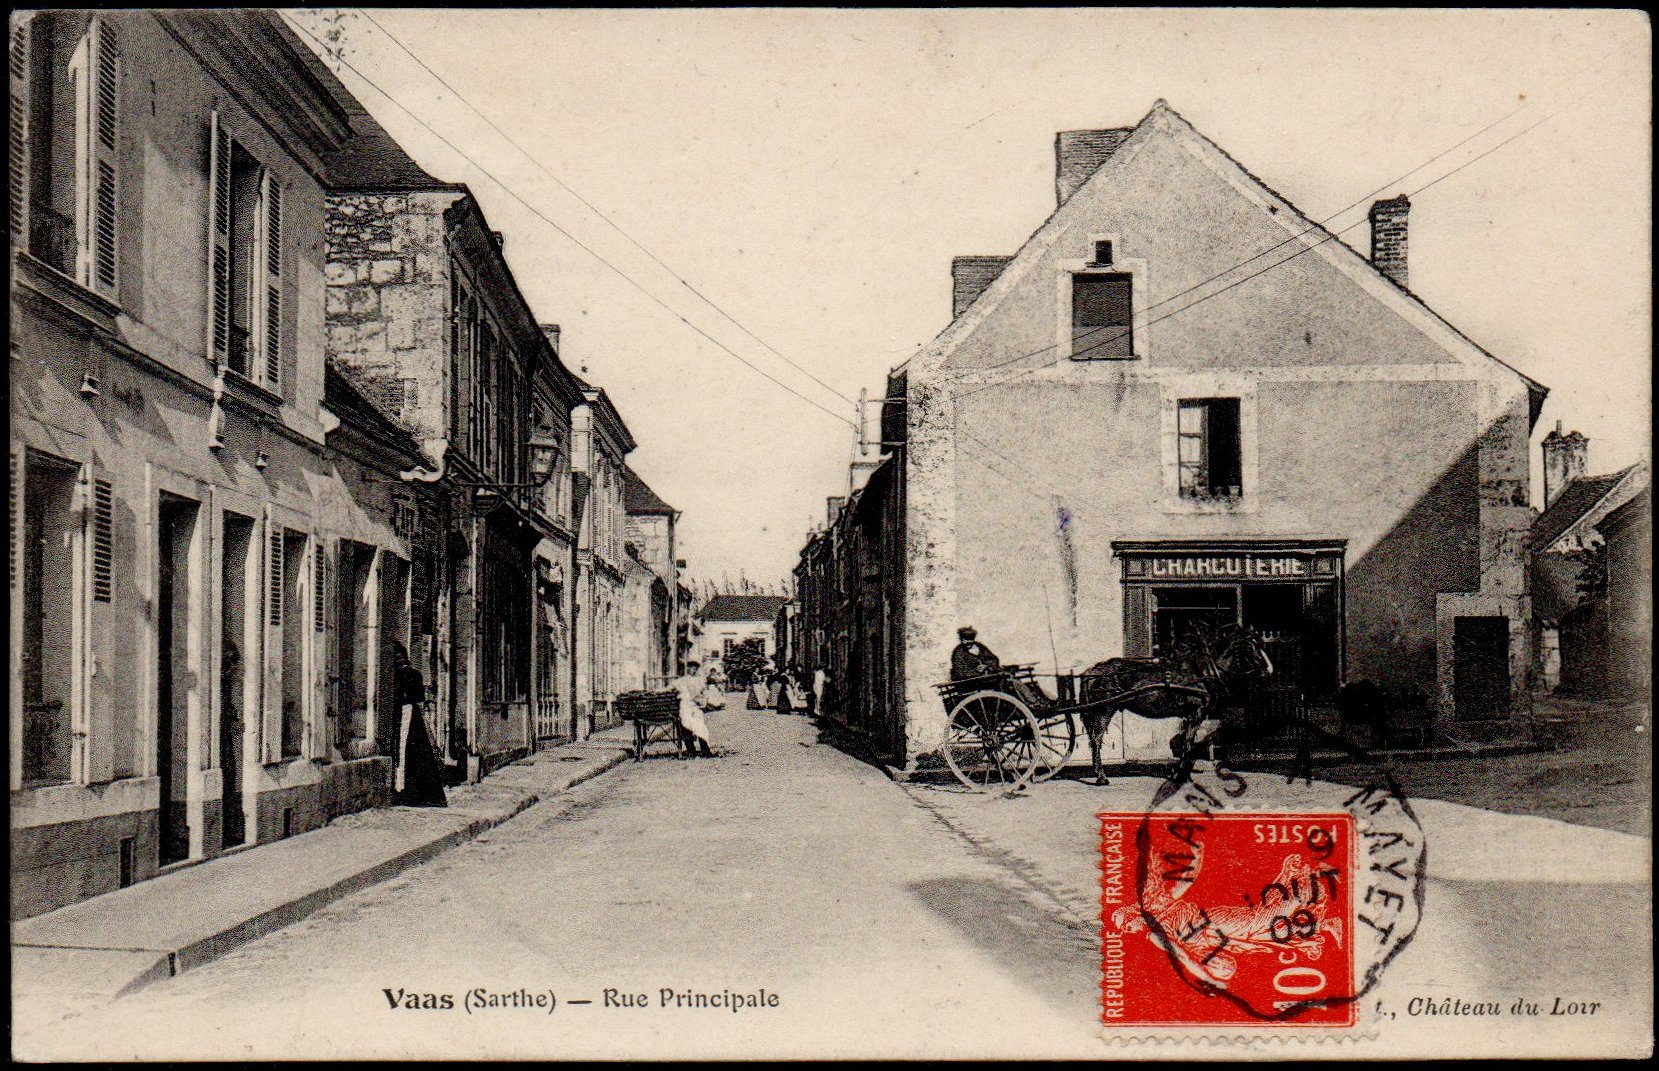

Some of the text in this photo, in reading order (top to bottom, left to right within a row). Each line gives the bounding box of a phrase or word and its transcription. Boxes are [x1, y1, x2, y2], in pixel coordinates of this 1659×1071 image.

[1152, 557, 1305, 576] CHARCUTERIE
[1342, 781, 1409, 945] MAYET
[1243, 867, 1340, 905] OUT
[1270, 909, 1317, 944] 09
